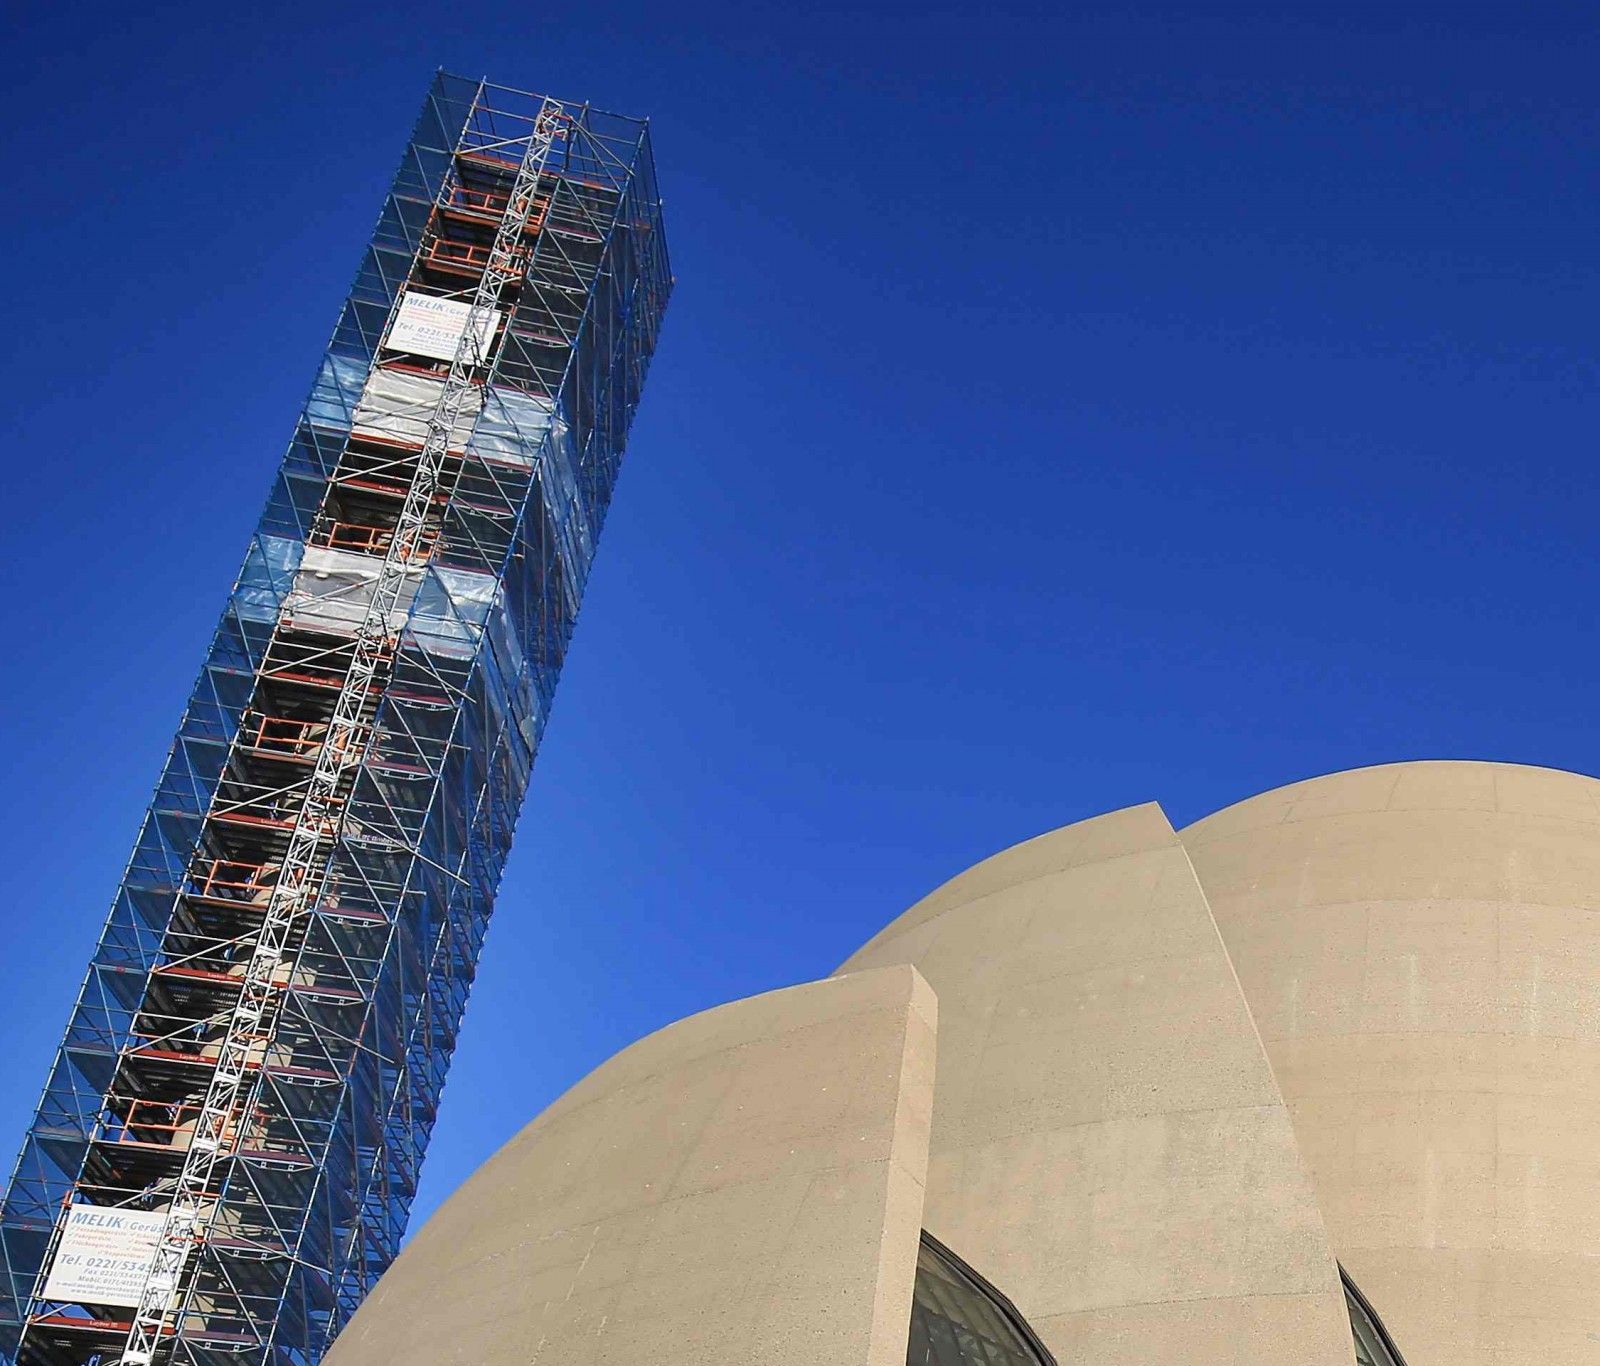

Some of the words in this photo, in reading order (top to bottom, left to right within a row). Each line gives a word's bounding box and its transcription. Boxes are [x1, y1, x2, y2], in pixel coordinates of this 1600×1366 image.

[406, 297, 445, 312] MELIK
[72, 1212, 125, 1229] MELIK
[59, 1253, 82, 1267] Tel.
